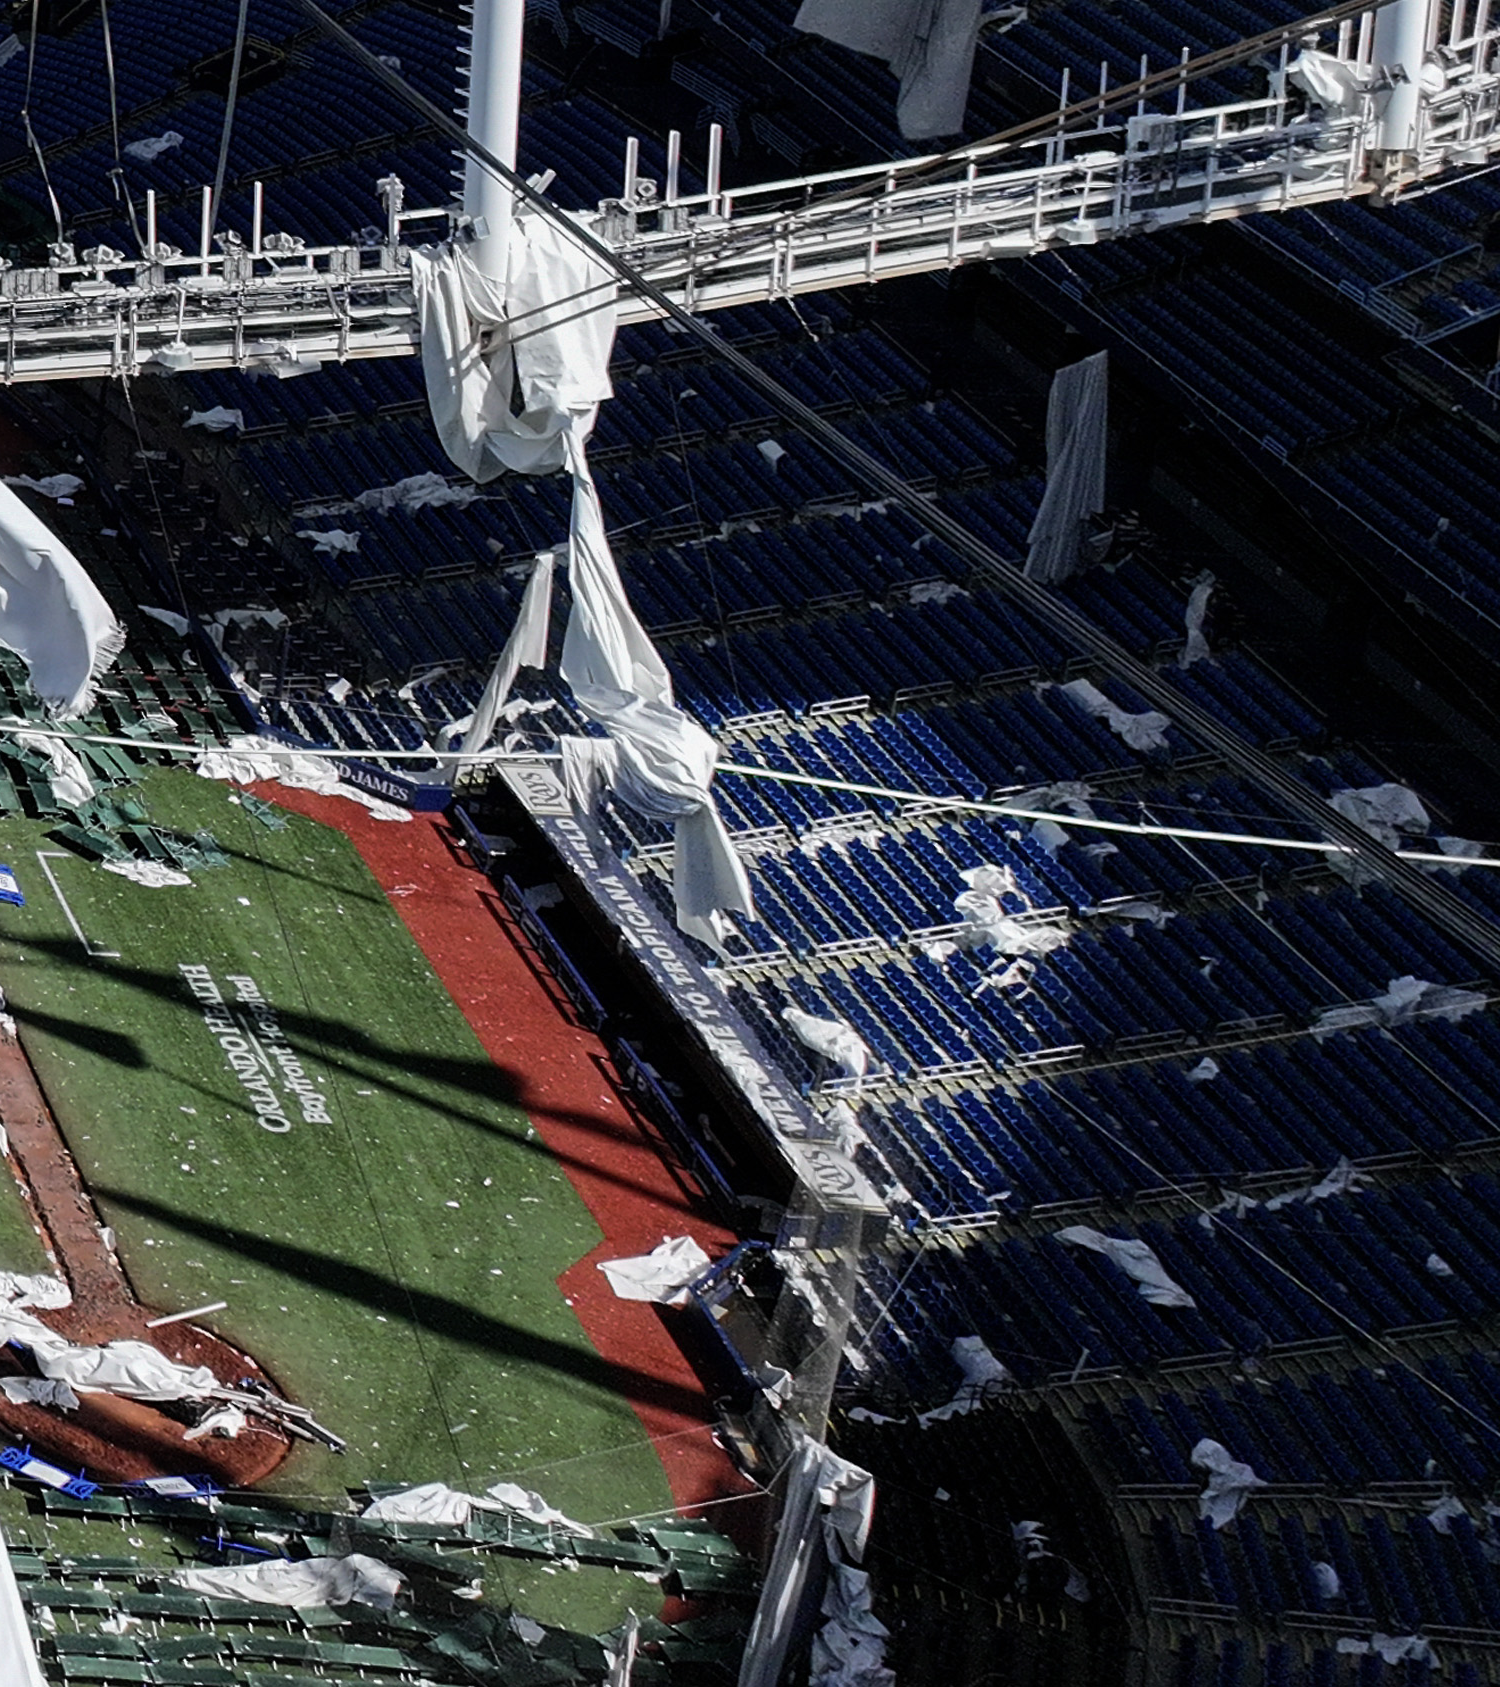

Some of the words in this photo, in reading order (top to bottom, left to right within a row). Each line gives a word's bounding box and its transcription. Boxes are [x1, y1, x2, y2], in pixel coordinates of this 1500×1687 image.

[350, 769, 409, 802] JAMES
[554, 817, 599, 870] FIELD
[594, 874, 698, 987] TROPICANA
[177, 962, 242, 1035] HEALTH
[225, 974, 289, 1045] Hospital
[684, 991, 722, 1020] TO
[218, 1035, 292, 1134] ORLANDO
[267, 1044, 333, 1125] Bayfront
